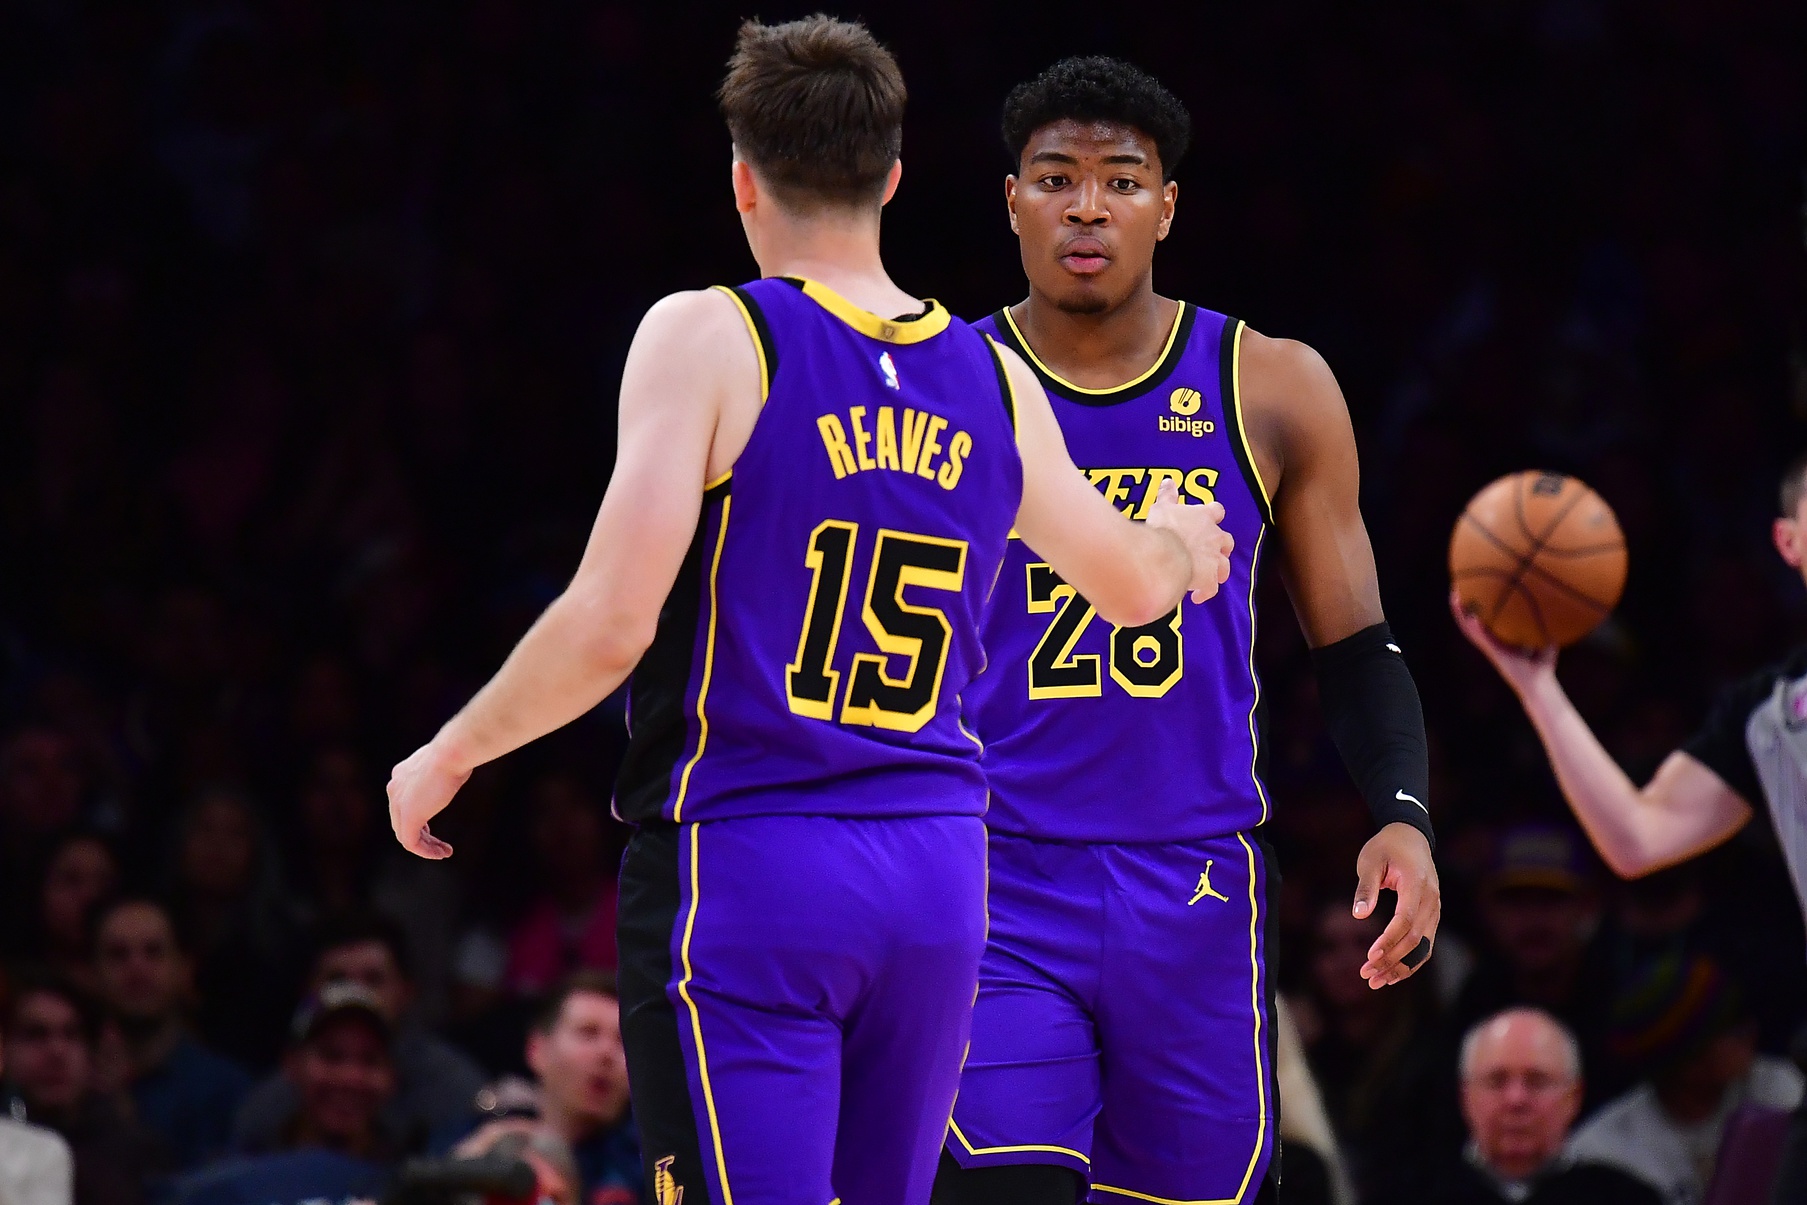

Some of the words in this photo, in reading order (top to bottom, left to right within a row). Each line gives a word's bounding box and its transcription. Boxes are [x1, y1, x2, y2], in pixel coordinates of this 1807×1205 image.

[816, 406, 973, 491] REAVES
[1158, 415, 1215, 437] bibigo
[785, 519, 968, 733] 15
[1027, 563, 1183, 699] 28
